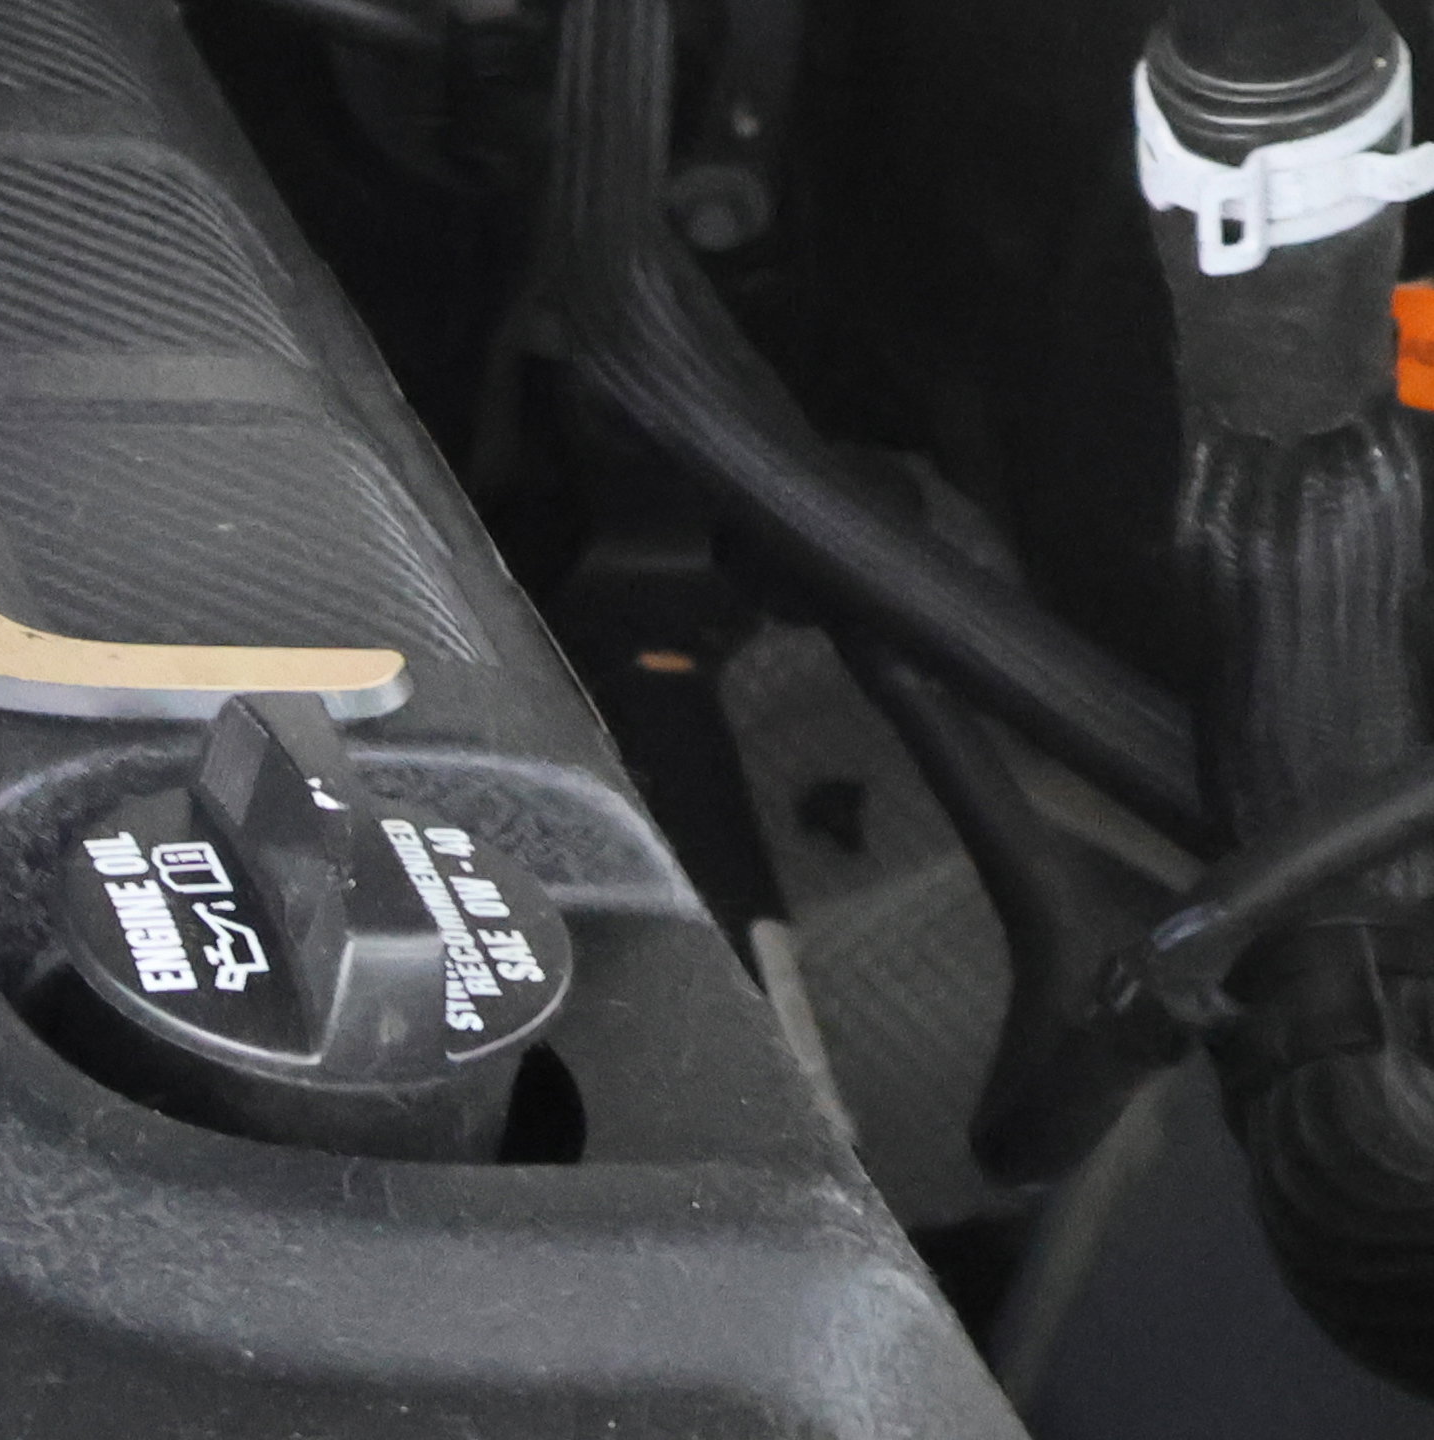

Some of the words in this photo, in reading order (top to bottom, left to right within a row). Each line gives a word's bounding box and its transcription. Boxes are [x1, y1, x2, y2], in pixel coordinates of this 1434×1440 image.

[83, 831, 149, 876] OIL
[104, 879, 198, 992] ENGINE
[380, 819, 503, 996] RECOMMENDED
[477, 929, 546, 982] SAE
